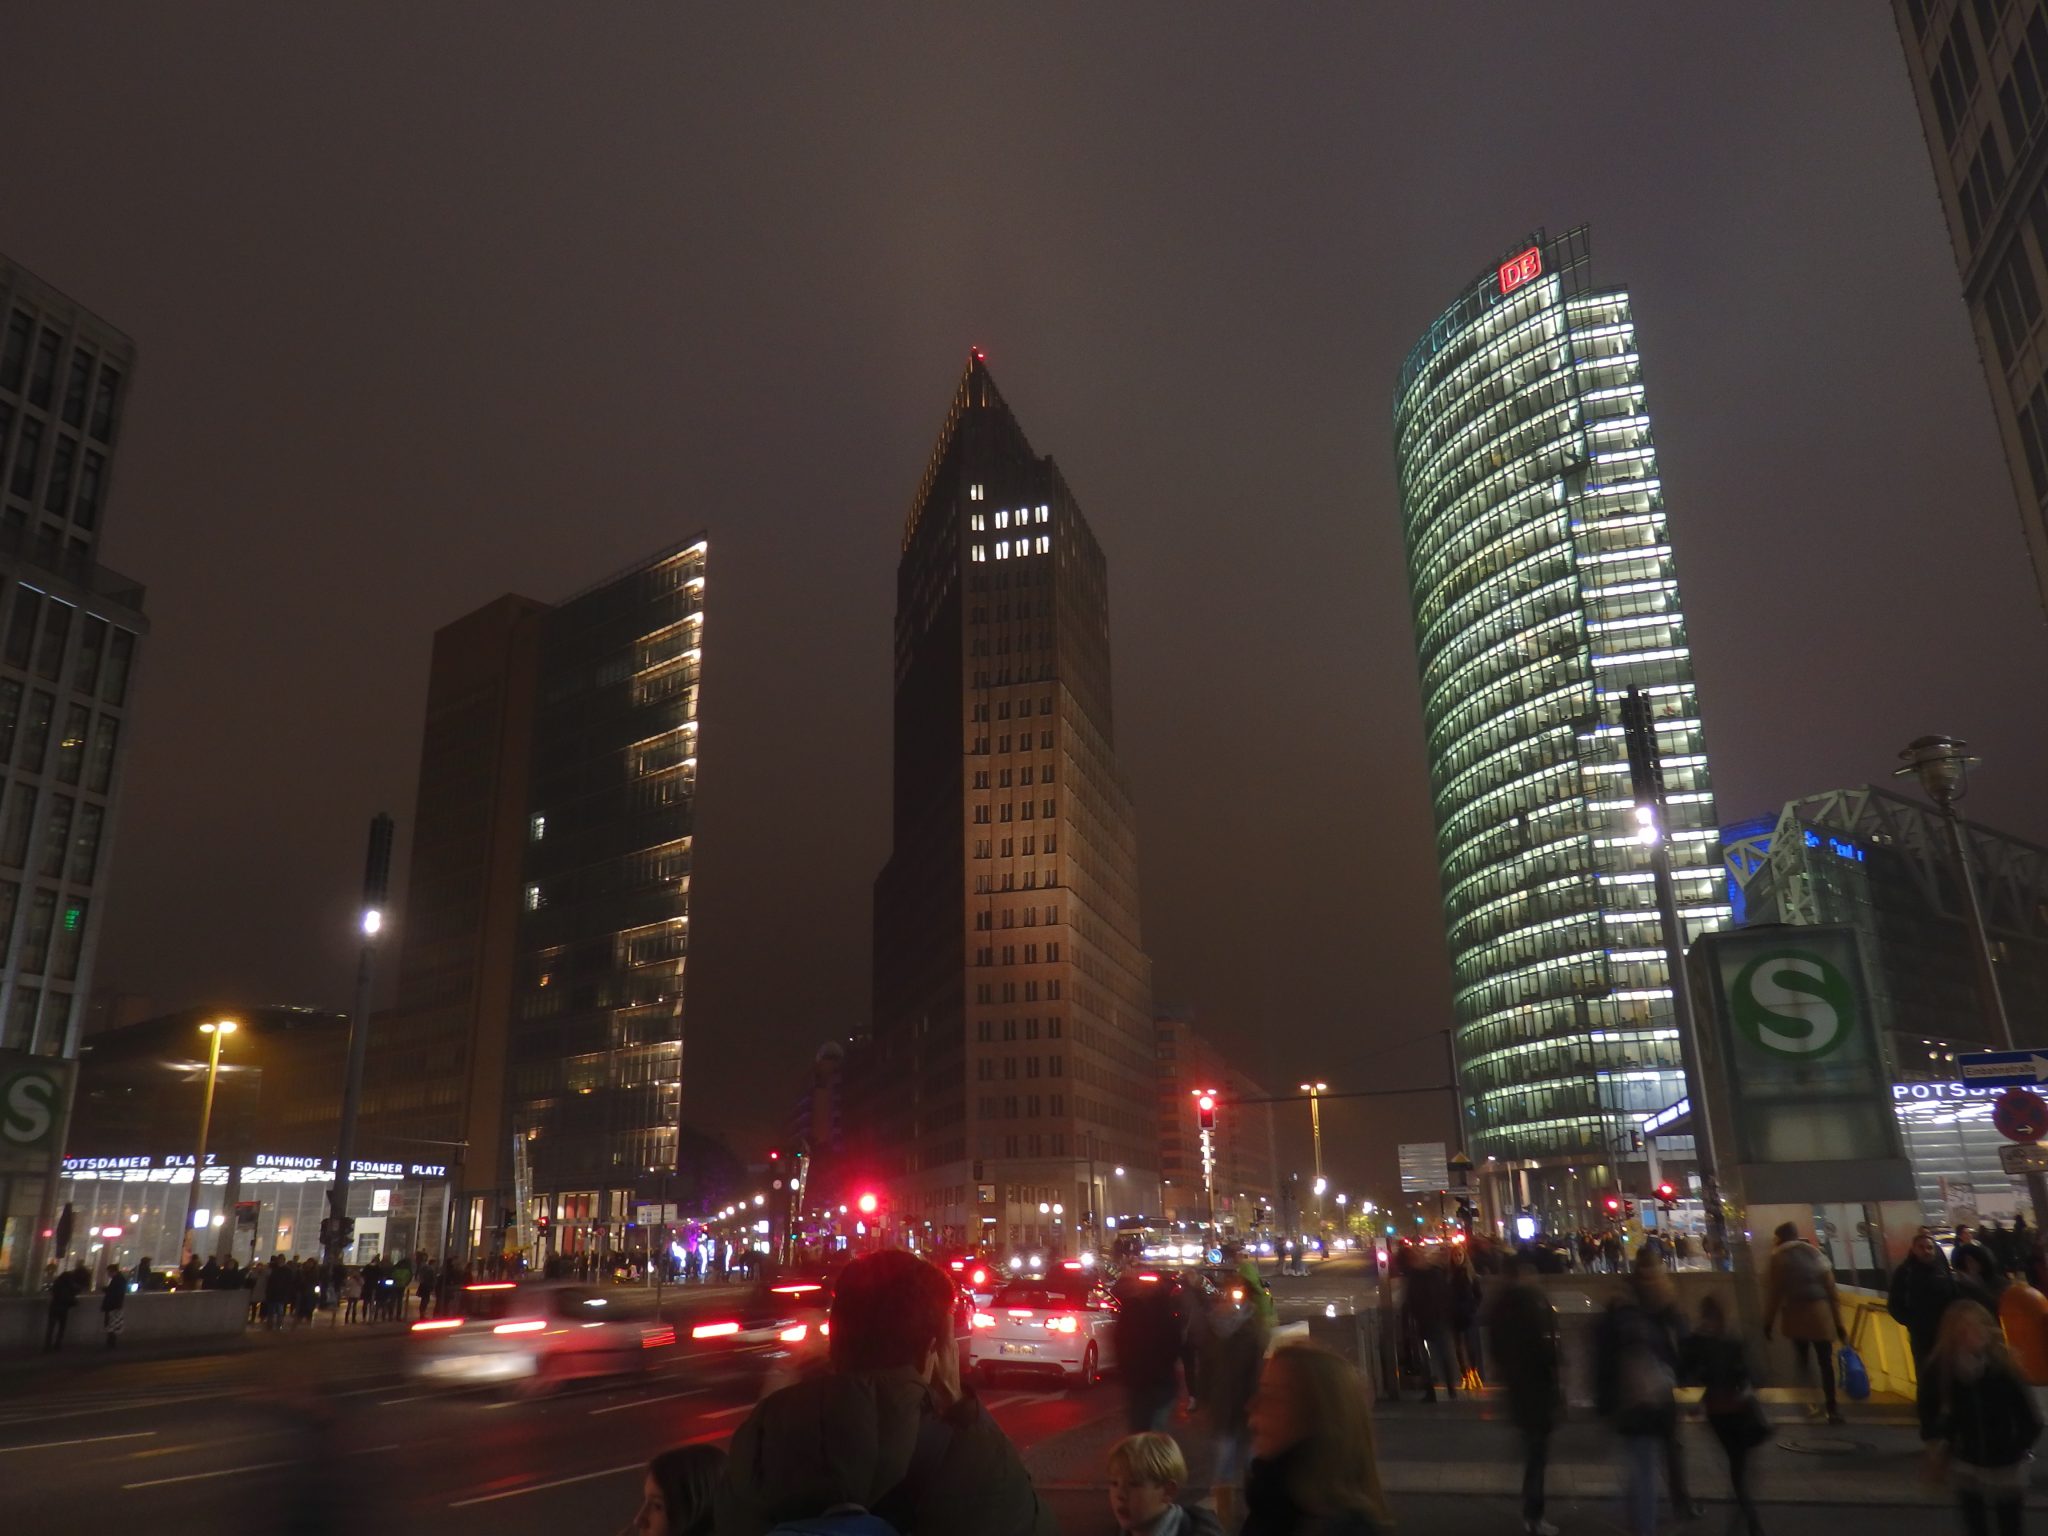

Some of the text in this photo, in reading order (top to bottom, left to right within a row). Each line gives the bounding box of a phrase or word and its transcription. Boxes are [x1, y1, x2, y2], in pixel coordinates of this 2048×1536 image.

[1502, 252, 1537, 289] DB
[1750, 957, 1839, 1053] S
[1892, 1083, 2047, 1099] POTSA
[3, 1076, 53, 1142] S
[165, 1154, 216, 1166] PLAZ
[256, 1154, 446, 1176] BAHNHOF TSDAMER PLATZ
